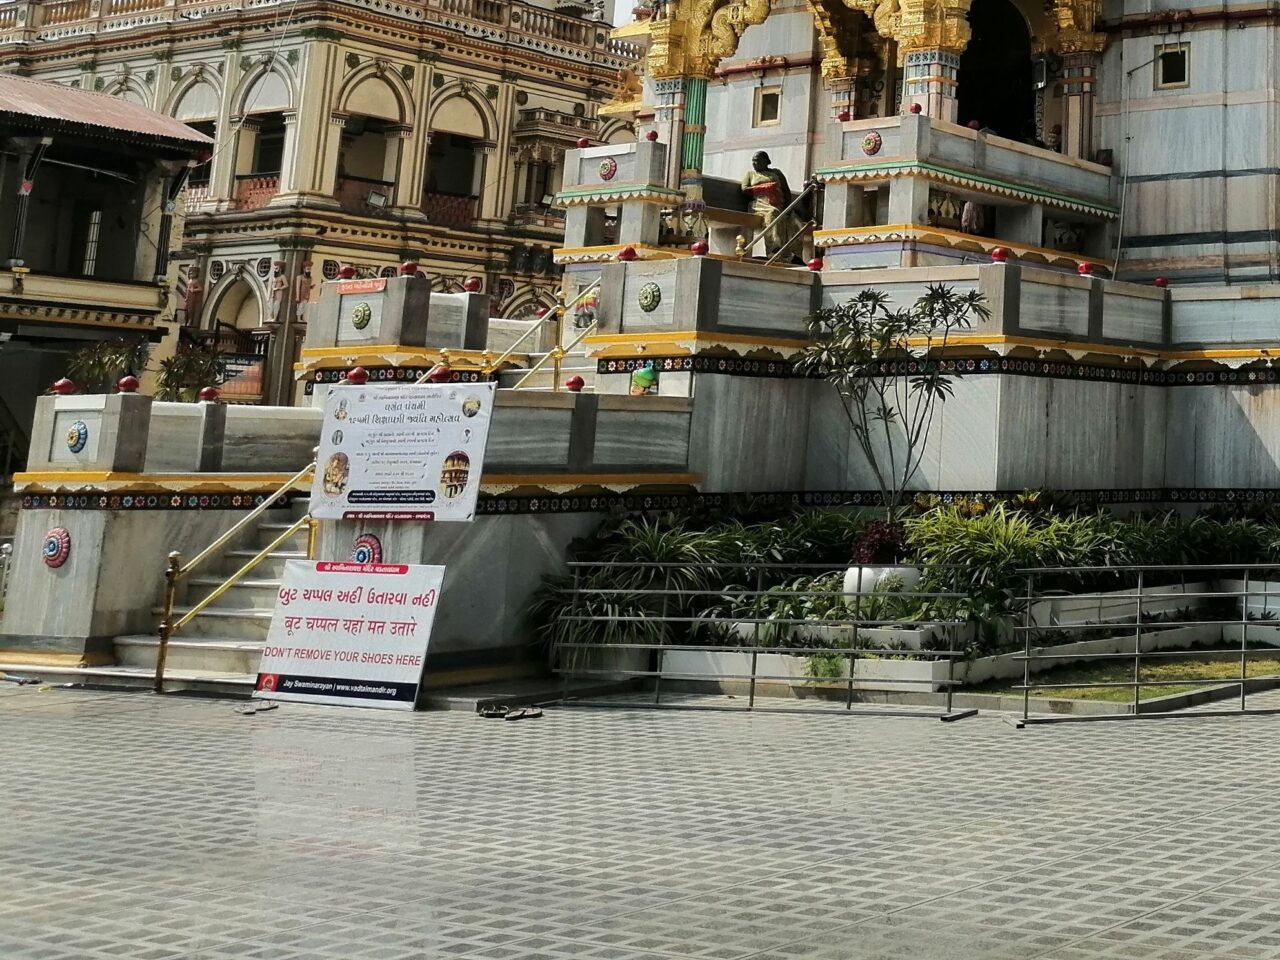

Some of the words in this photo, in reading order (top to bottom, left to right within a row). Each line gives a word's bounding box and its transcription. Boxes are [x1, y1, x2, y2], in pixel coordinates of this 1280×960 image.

[279, 588, 297, 606] બુટ
[303, 588, 333, 602] ચપ્પલ
[337, 585, 363, 604] અહીં
[367, 587, 407, 605] ઉતારવા
[284, 616, 303, 637] बूट
[306, 616, 340, 633] चप्पल
[343, 615, 364, 636] यहां
[367, 620, 386, 635] मत
[264, 646, 293, 658] DON'T
[294, 648, 331, 661] REMOVE
[334, 650, 360, 663] YOUR
[361, 652, 393, 665] SHOES
[396, 653, 422, 666] HERE
[283, 679, 294, 688] Jay
[294, 681, 333, 691] Swaminarayan
[336, 683, 397, 696] www.vadtalmandir.org
